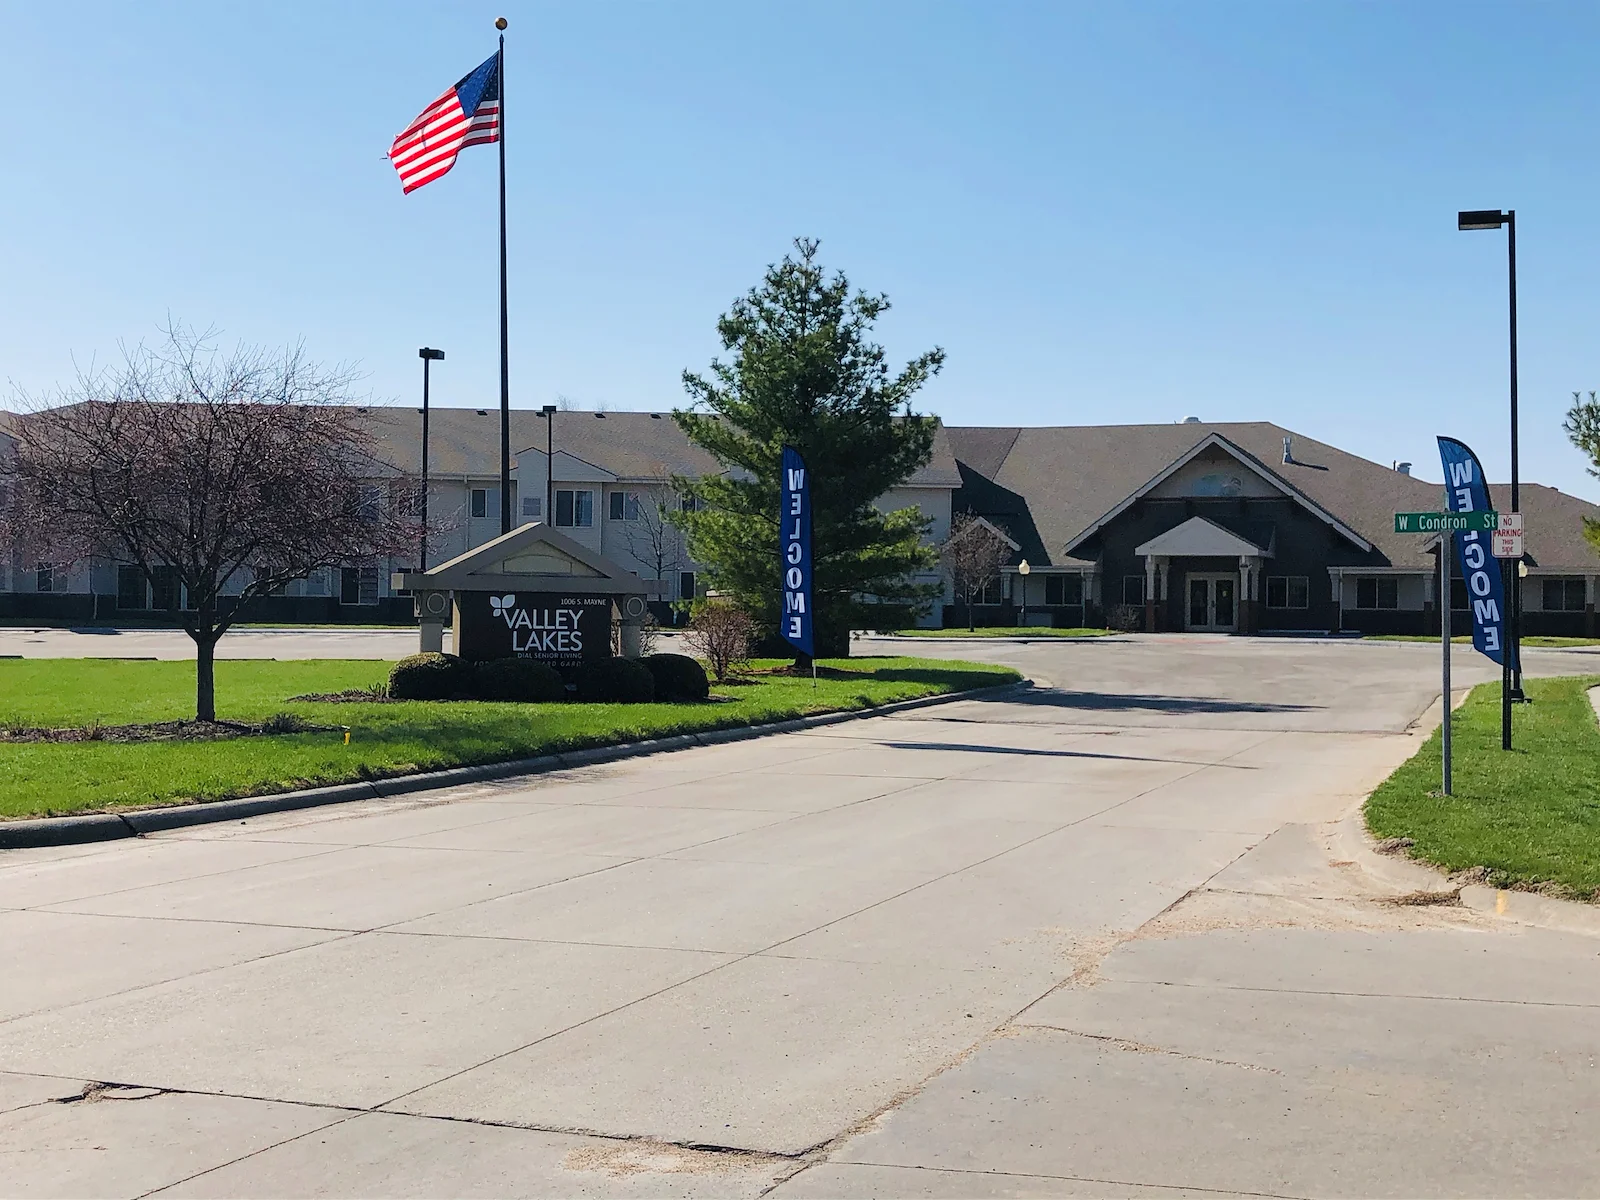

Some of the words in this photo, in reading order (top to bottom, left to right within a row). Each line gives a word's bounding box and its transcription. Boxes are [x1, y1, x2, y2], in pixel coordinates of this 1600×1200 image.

[1399, 516, 1408, 530] W
[1419, 515, 1467, 530] Condron
[1483, 513, 1496, 529] St
[1503, 517, 1513, 527] NO
[1493, 528, 1522, 537] PARKING
[561, 598, 576, 606] 1006
[502, 609, 584, 629] VALLEY
[513, 631, 583, 651] LAKES
